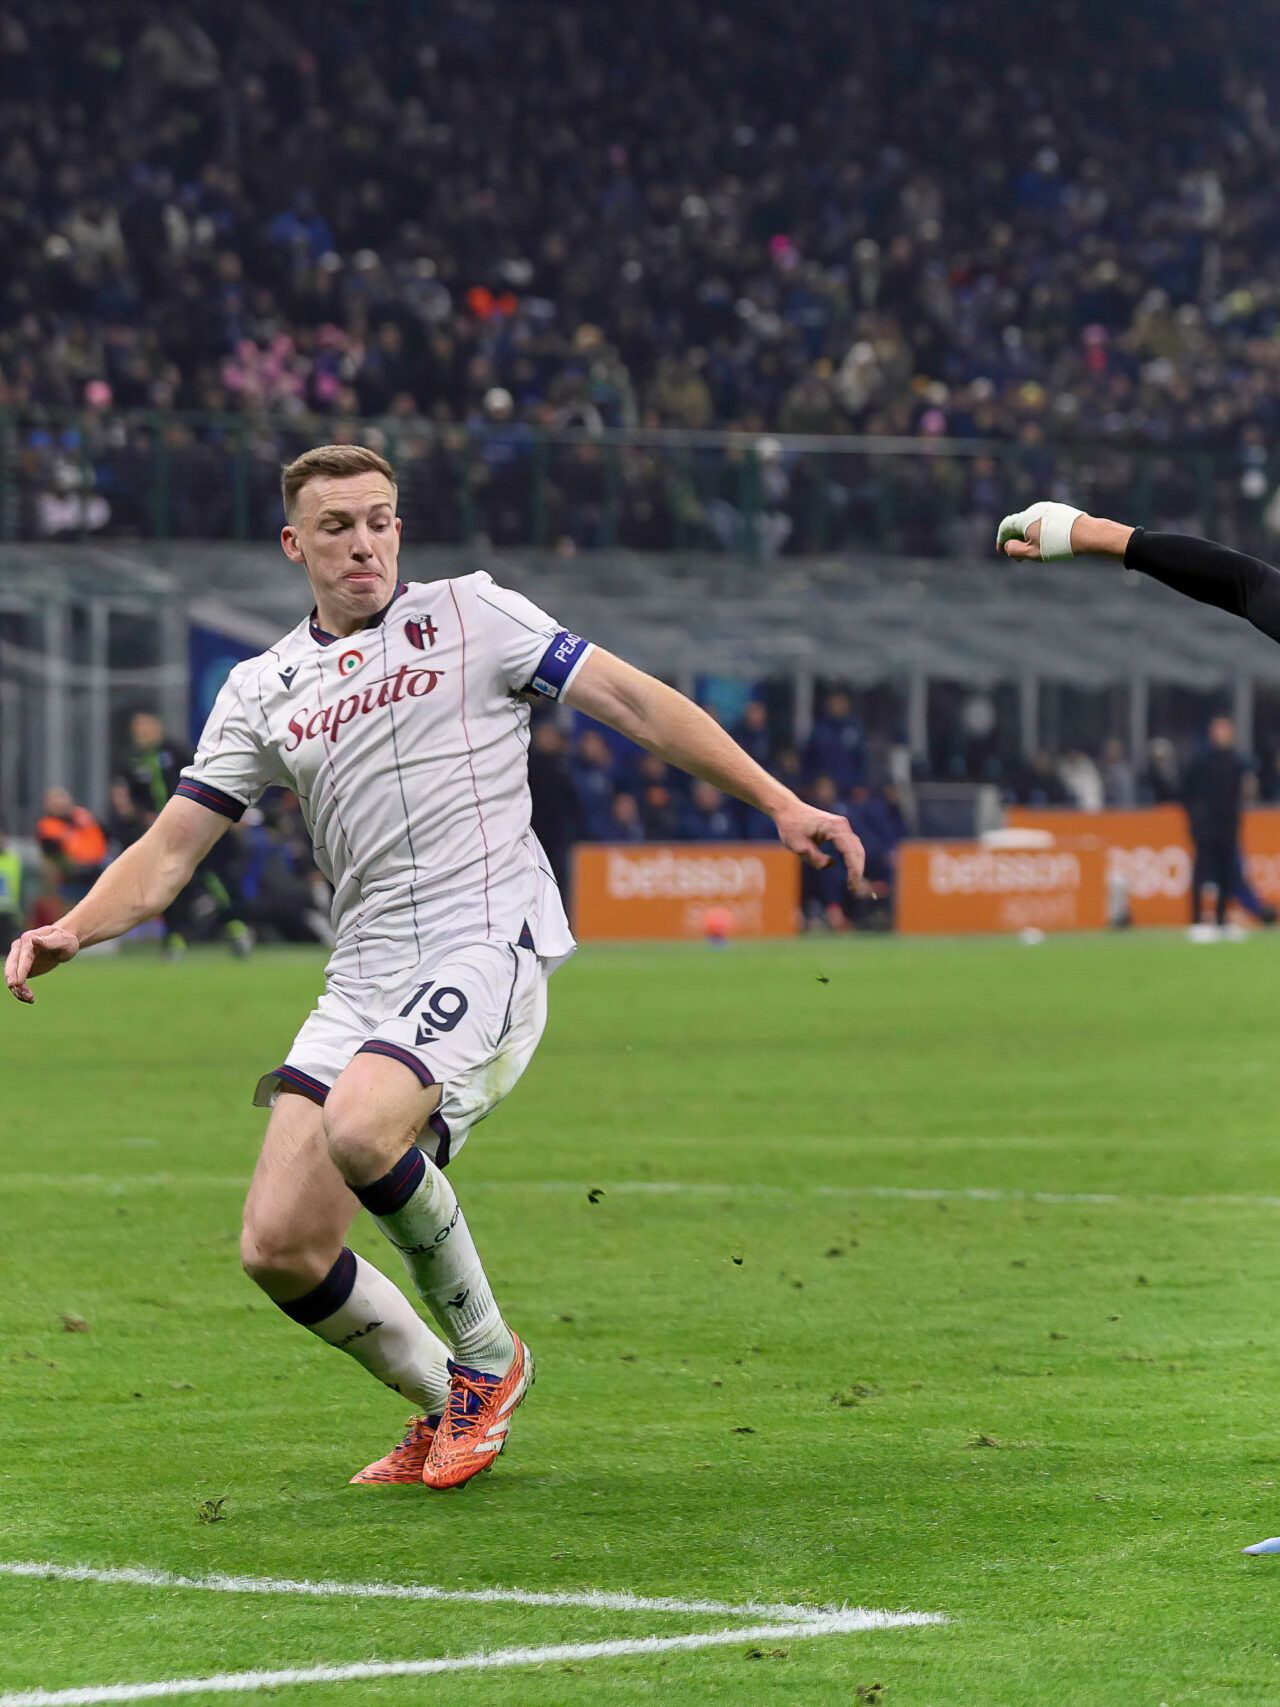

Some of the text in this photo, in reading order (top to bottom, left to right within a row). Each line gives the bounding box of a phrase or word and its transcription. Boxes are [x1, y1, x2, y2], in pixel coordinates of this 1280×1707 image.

[285, 664, 445, 752] Saputo
[606, 850, 767, 900] betsson
[398, 980, 469, 1033] 19
